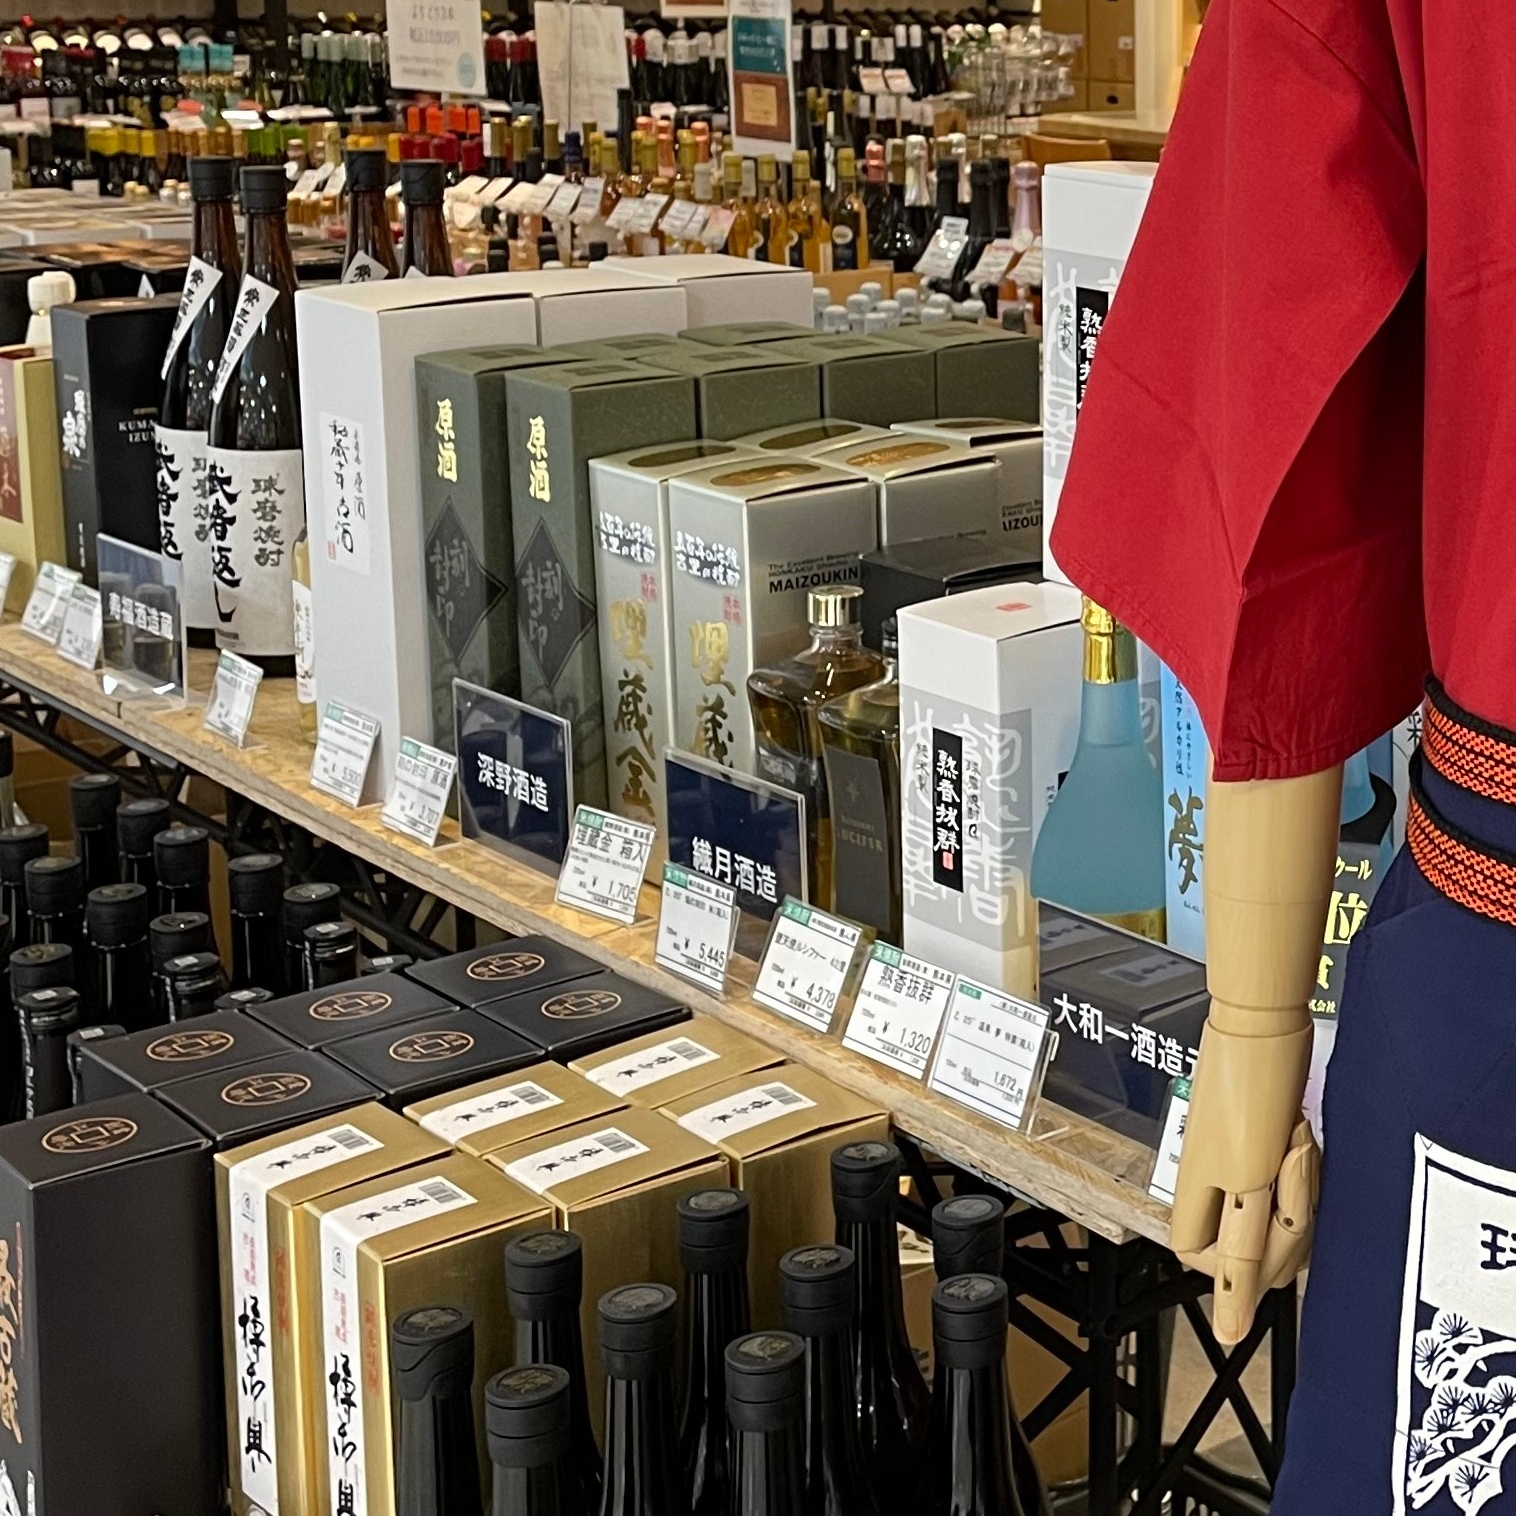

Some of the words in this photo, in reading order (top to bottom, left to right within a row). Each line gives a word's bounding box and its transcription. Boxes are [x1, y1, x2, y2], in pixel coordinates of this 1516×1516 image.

[435, 398, 459, 483] 原酒
[526, 415, 551, 503] 原酒
[251, 472, 286, 568] 球磨焼酎
[769, 566, 859, 594] MAIZOUKIN
[477, 751, 550, 813] 深野酒造
[608, 880, 638, 903] 1,705
[699, 943, 726, 969] 5,445
[806, 983, 836, 1010] 4,378
[900, 1027, 932, 1055] 1,320
